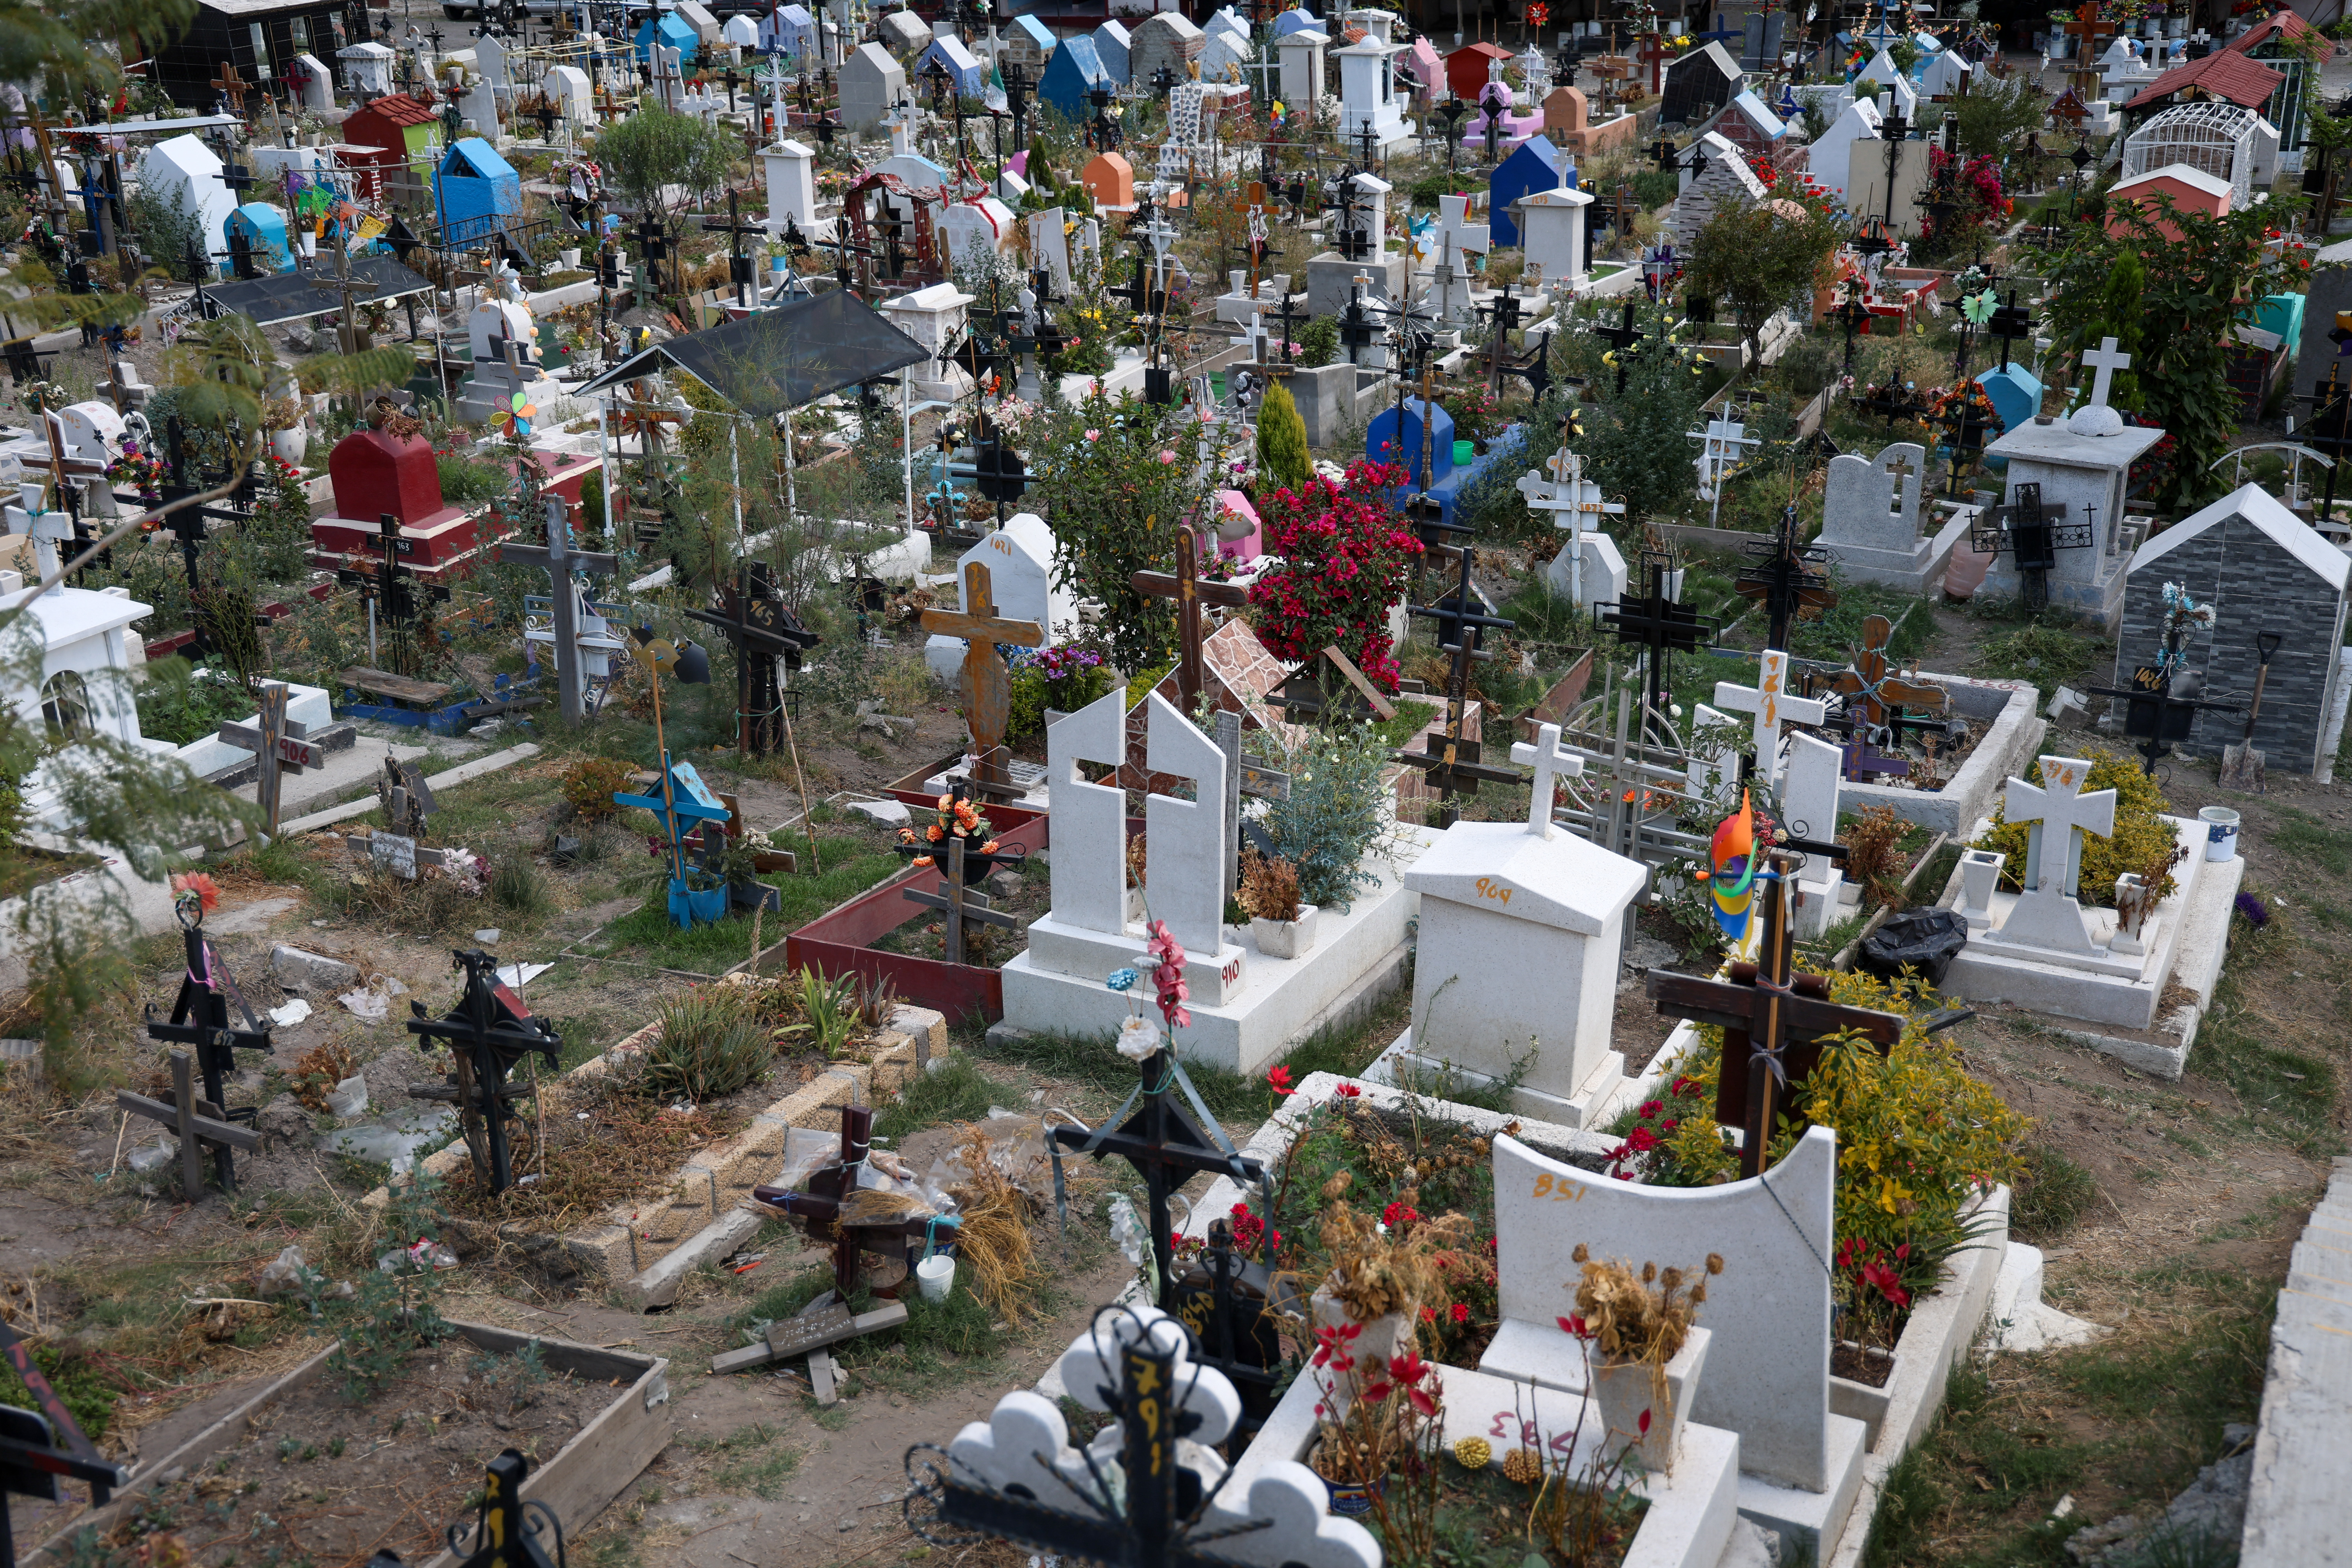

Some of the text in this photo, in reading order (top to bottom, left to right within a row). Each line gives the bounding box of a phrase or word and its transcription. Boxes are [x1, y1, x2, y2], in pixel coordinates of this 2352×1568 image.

[1532, 196, 1548, 205] 1273
[989, 278, 998, 316] 1163
[62, 410, 81, 429] 1015
[397, 541, 410, 552] 963
[990, 537, 1011, 557] 1021
[750, 600, 775, 626] 965
[279, 738, 310, 765] 906
[1475, 877, 1512, 906] 909
[1221, 959, 1240, 989] 910
[1532, 1173, 1586, 1203] 851
